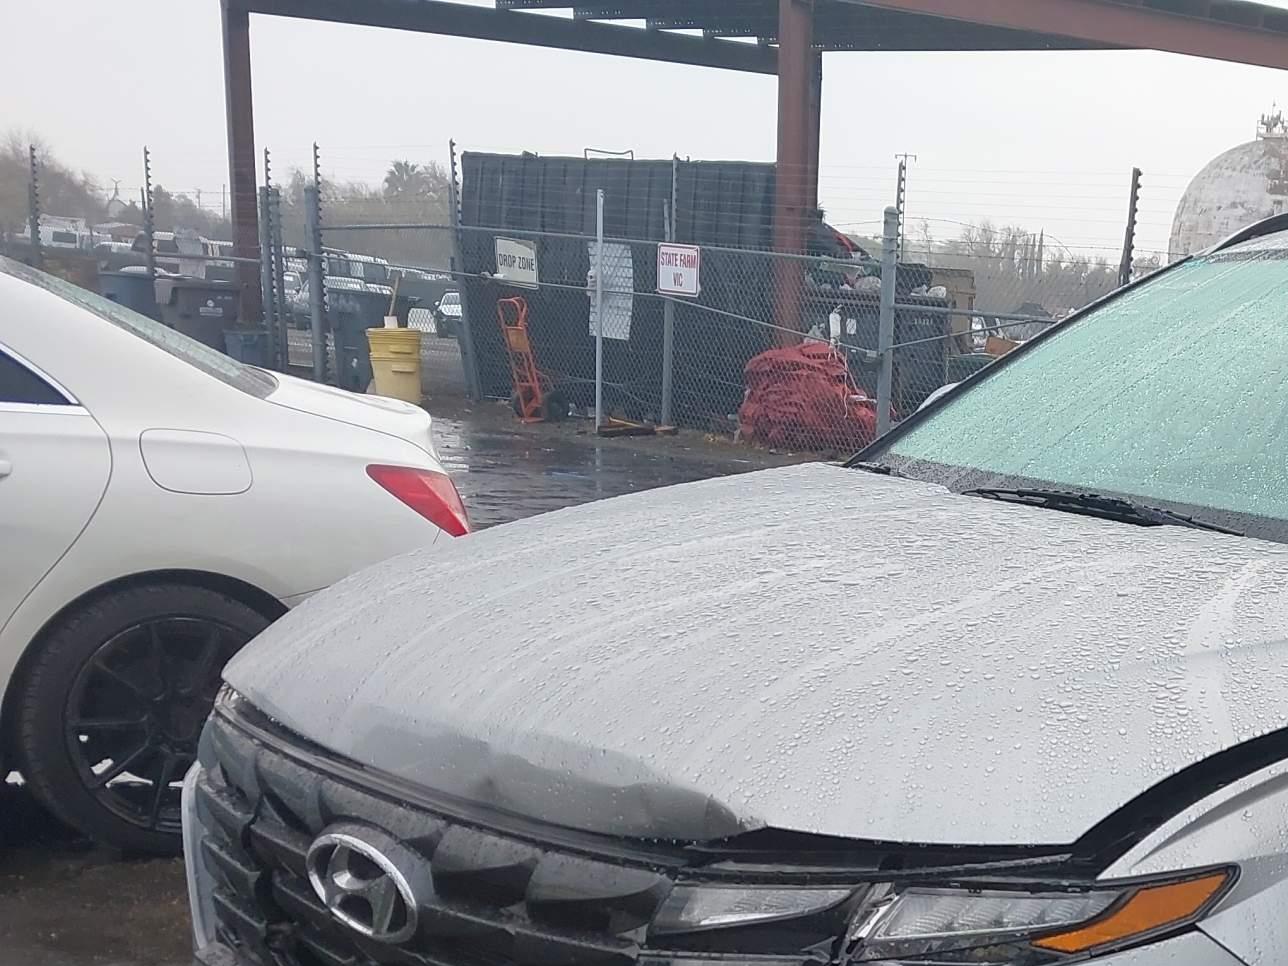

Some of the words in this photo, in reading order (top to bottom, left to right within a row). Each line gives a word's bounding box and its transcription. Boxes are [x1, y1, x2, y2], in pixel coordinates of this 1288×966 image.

[499, 253, 516, 268] DROP
[518, 256, 535, 272] ZONE
[661, 252, 679, 267] STATE
[680, 254, 697, 269] FARM
[673, 272, 684, 287] VIC
